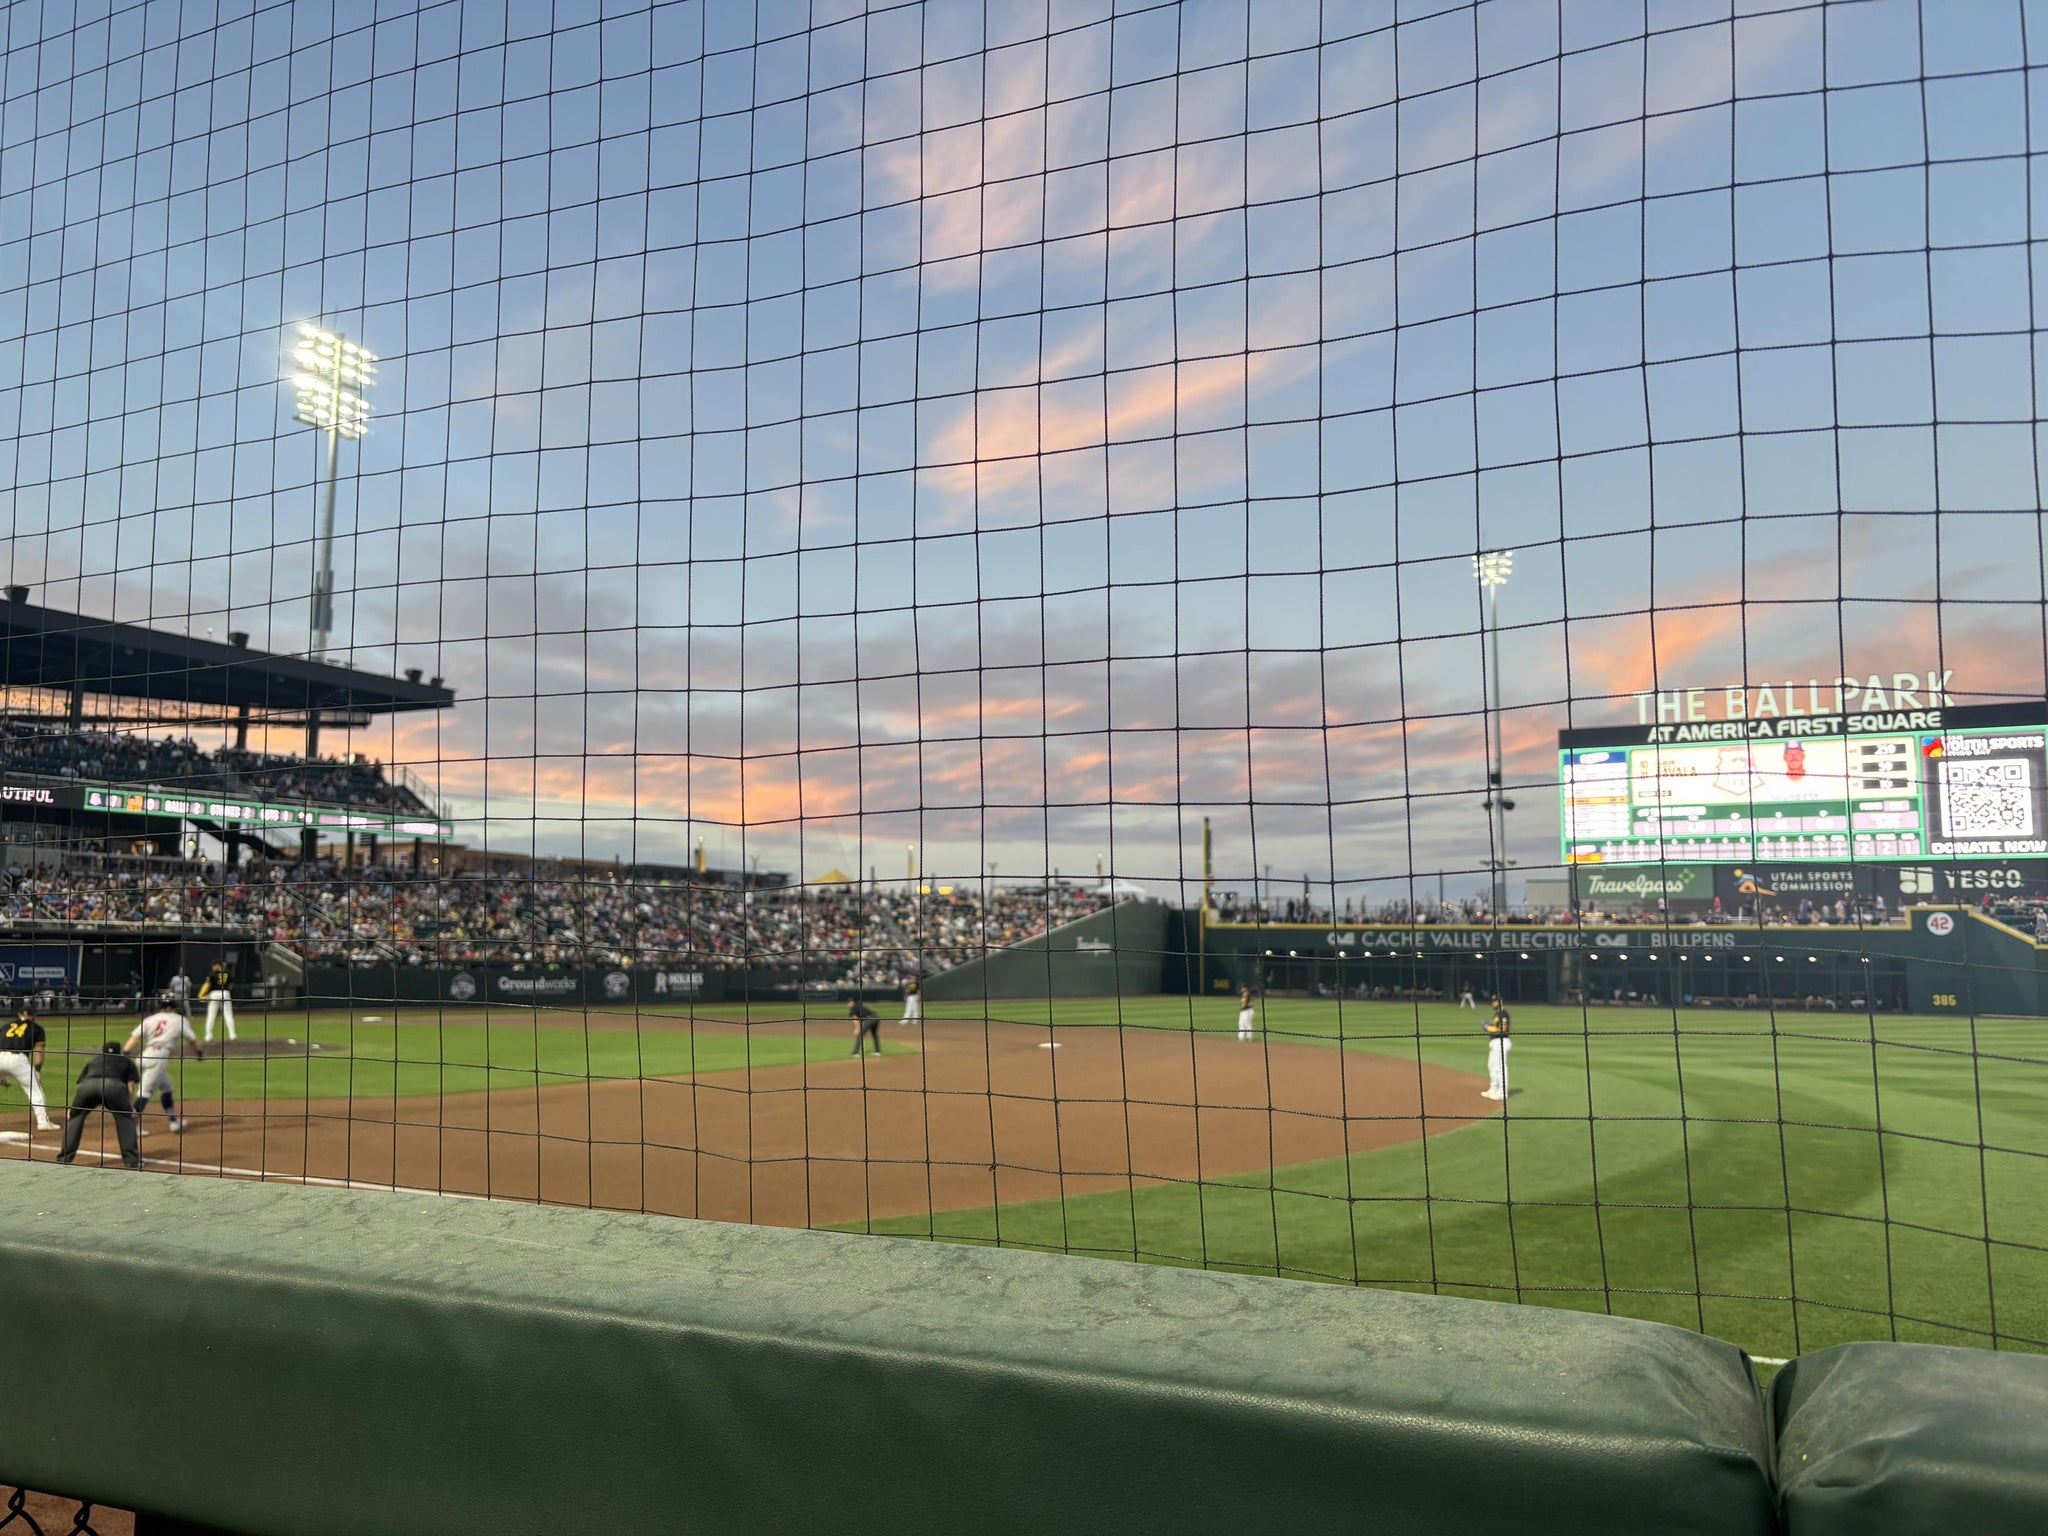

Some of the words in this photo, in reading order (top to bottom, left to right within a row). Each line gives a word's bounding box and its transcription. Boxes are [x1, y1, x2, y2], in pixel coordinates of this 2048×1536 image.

[1632, 687, 1706, 725] THE
[1725, 669, 1956, 720] BALLPARK
[1647, 726, 1674, 743] AT
[1676, 720, 1773, 742] AMERICA
[1777, 716, 1843, 737] FIRST
[1847, 711, 1941, 731] SQUARE
[1989, 736, 2044, 749] SPORTS
[0, 786, 54, 803] UTIFUL
[1931, 841, 2002, 854] DONATE
[2004, 840, 2047, 852] NOW
[1770, 872, 1803, 881] UTAH
[1807, 871, 1853, 881] SPORTS
[1943, 869, 2021, 889] YESCO
[1588, 874, 1684, 898] Travelpass
[1771, 882, 1854, 891] COMMISSION
[1930, 917, 1949, 930] 42
[1361, 931, 1425, 947] CACHE
[1430, 931, 1494, 947] VALLEY
[1501, 931, 1587, 948] ELECTRIC
[1651, 932, 1735, 948] BULLPENS
[6, 1023, 28, 1038] 24
